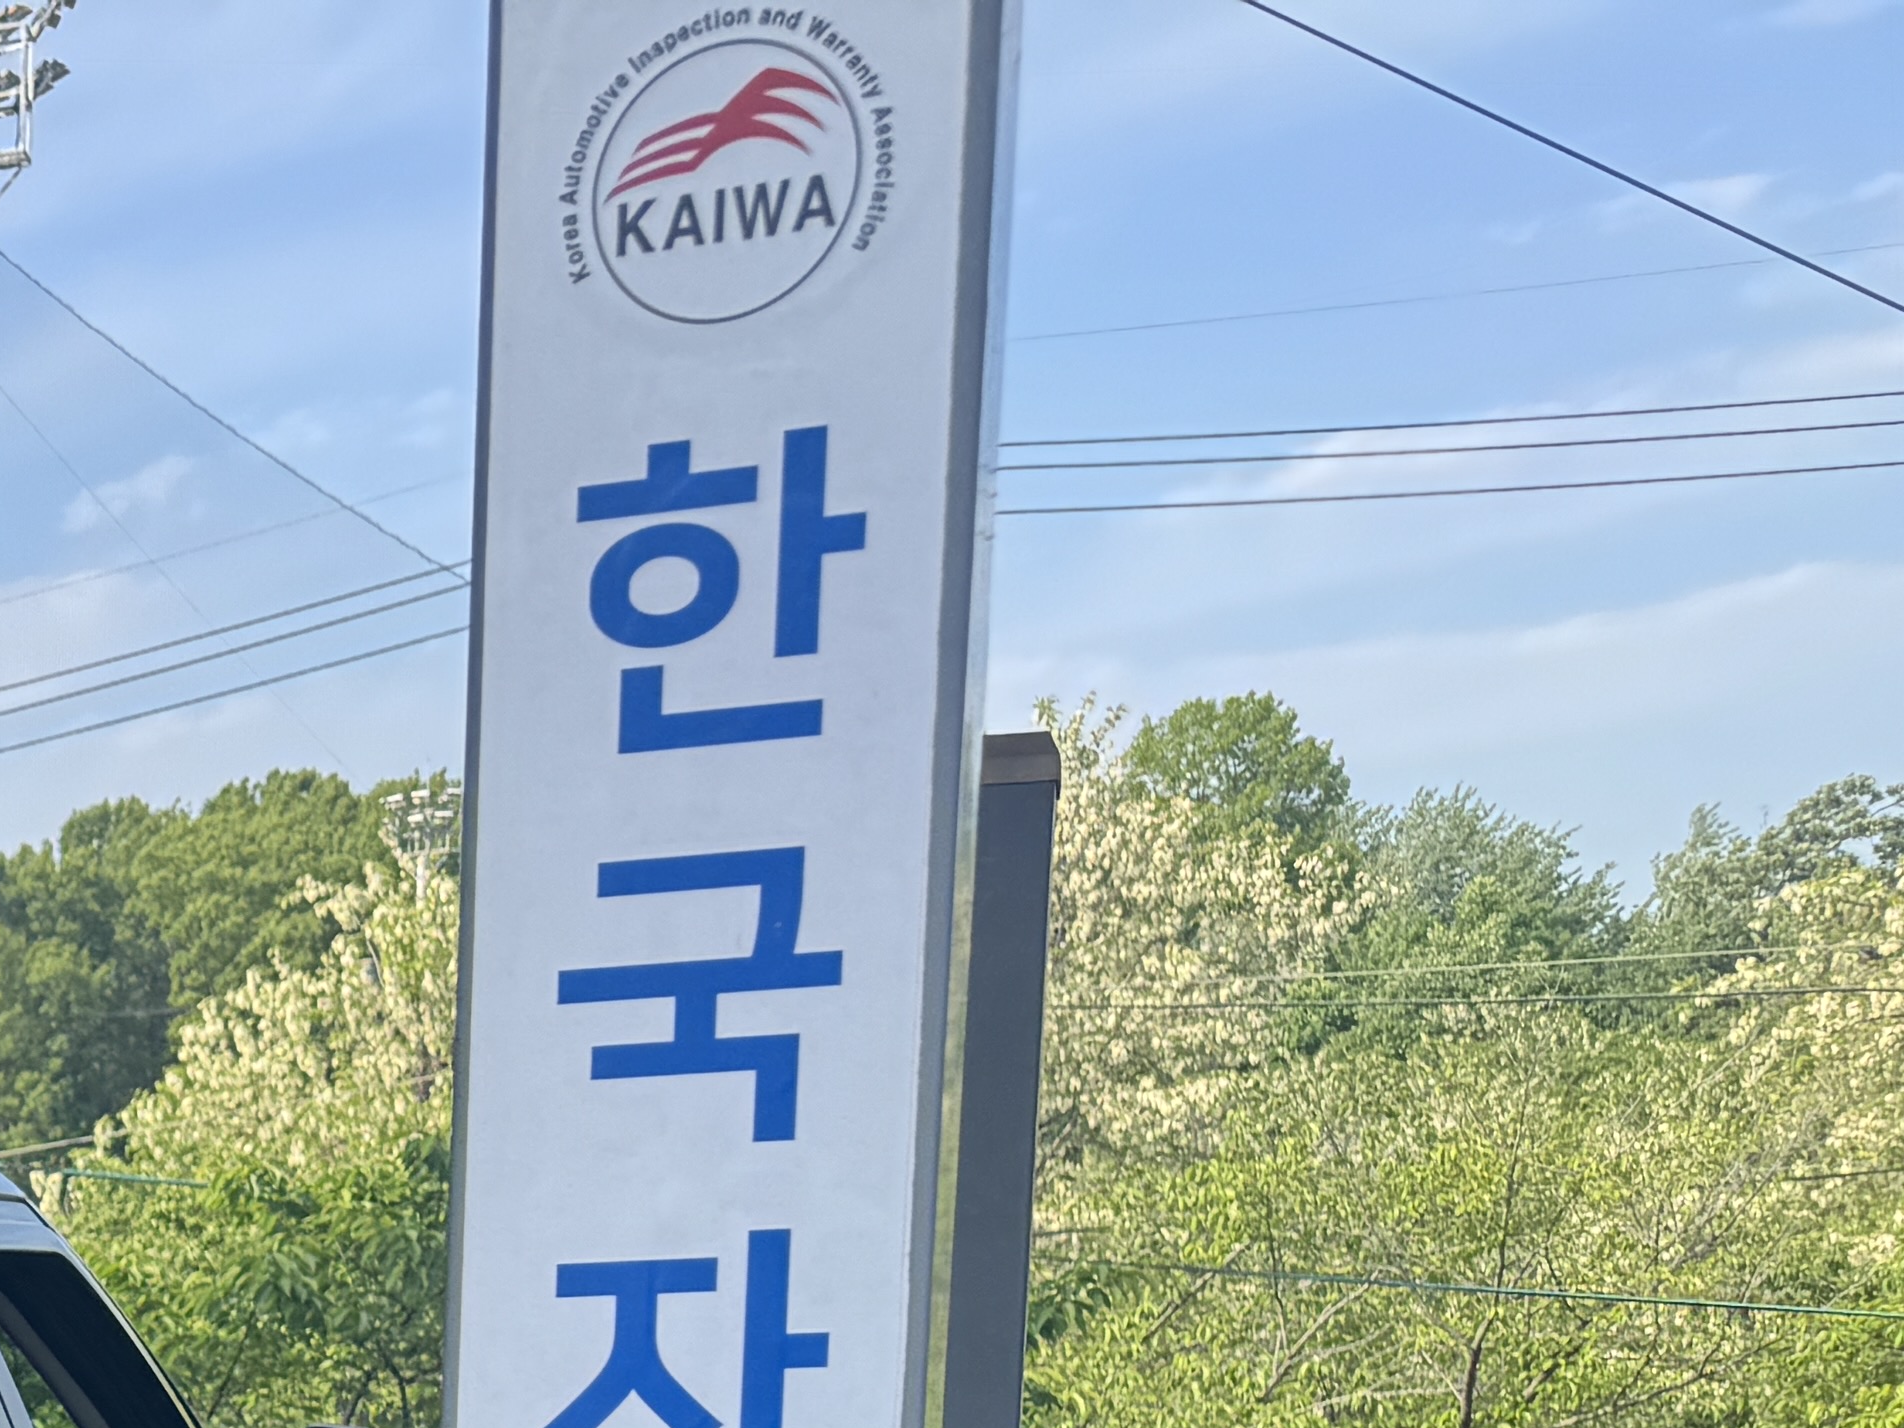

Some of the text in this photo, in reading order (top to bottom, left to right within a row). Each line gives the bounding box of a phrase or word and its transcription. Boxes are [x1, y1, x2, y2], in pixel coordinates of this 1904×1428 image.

[559, 7, 895, 285] Korea Automotive Inspection and Warranty Association
[615, 174, 837, 258] KAIWA
